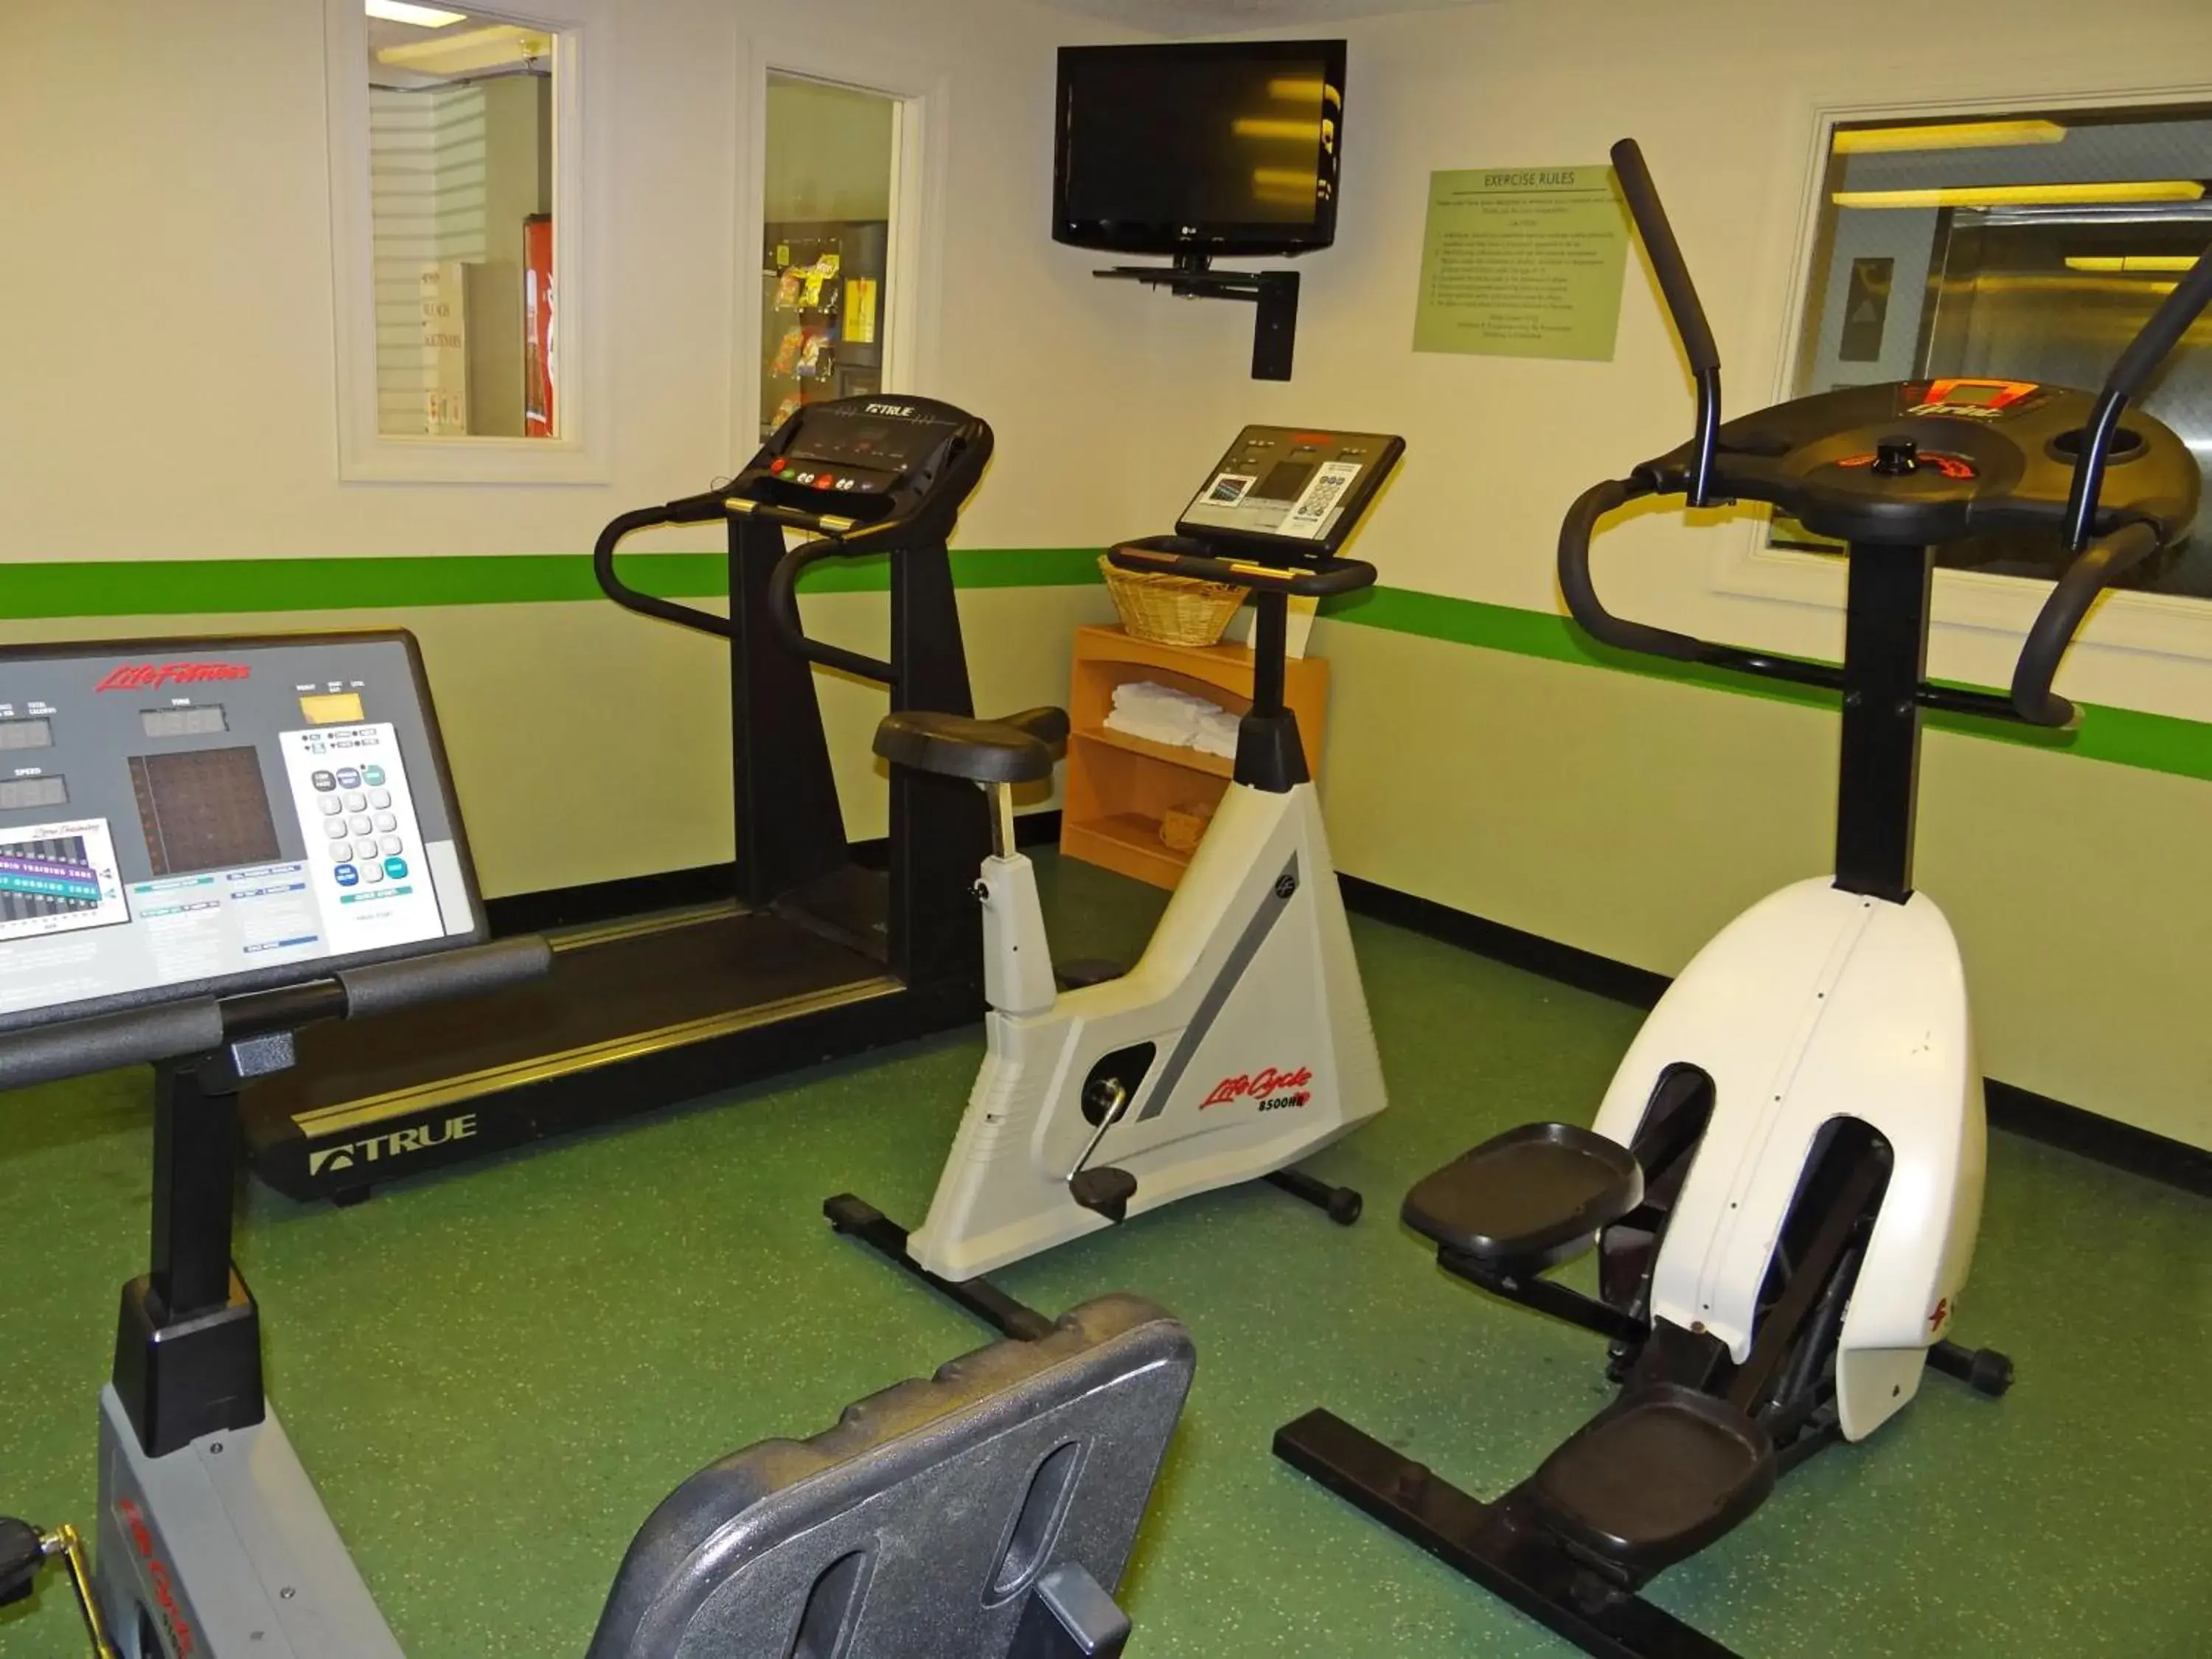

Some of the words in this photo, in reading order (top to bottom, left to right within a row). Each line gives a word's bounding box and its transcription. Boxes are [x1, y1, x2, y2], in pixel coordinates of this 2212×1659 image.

[1484, 173, 1535, 187] EXERCISE
[1539, 171, 1575, 185] RULES
[355, 1113, 477, 1162] TRUE
